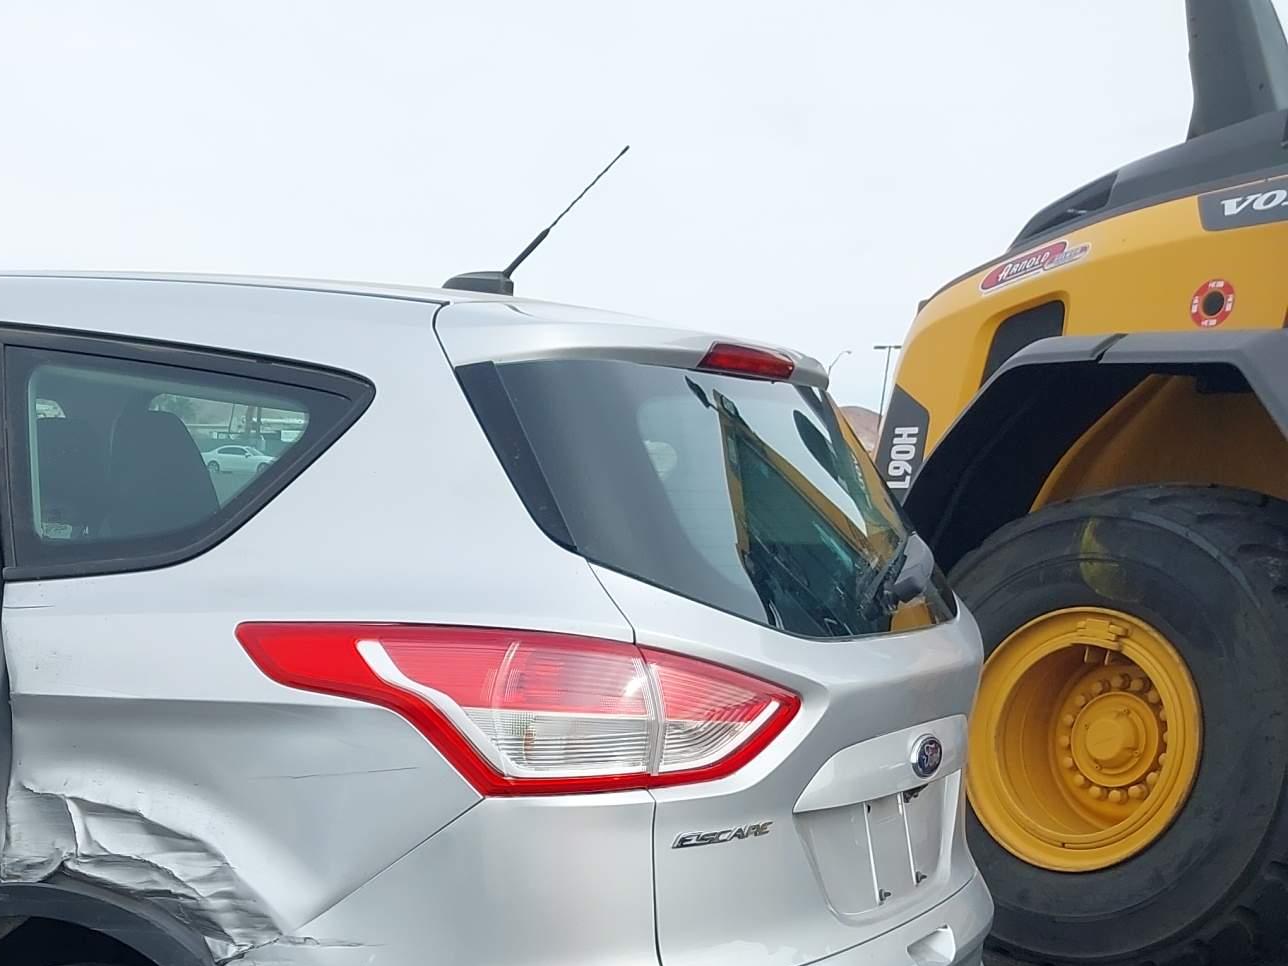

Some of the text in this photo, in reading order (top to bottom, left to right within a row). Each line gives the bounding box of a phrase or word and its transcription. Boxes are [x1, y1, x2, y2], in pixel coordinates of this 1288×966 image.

[1220, 189, 1288, 216] VO
[886, 427, 919, 488] L90H
[671, 820, 773, 849] ESCAPE
